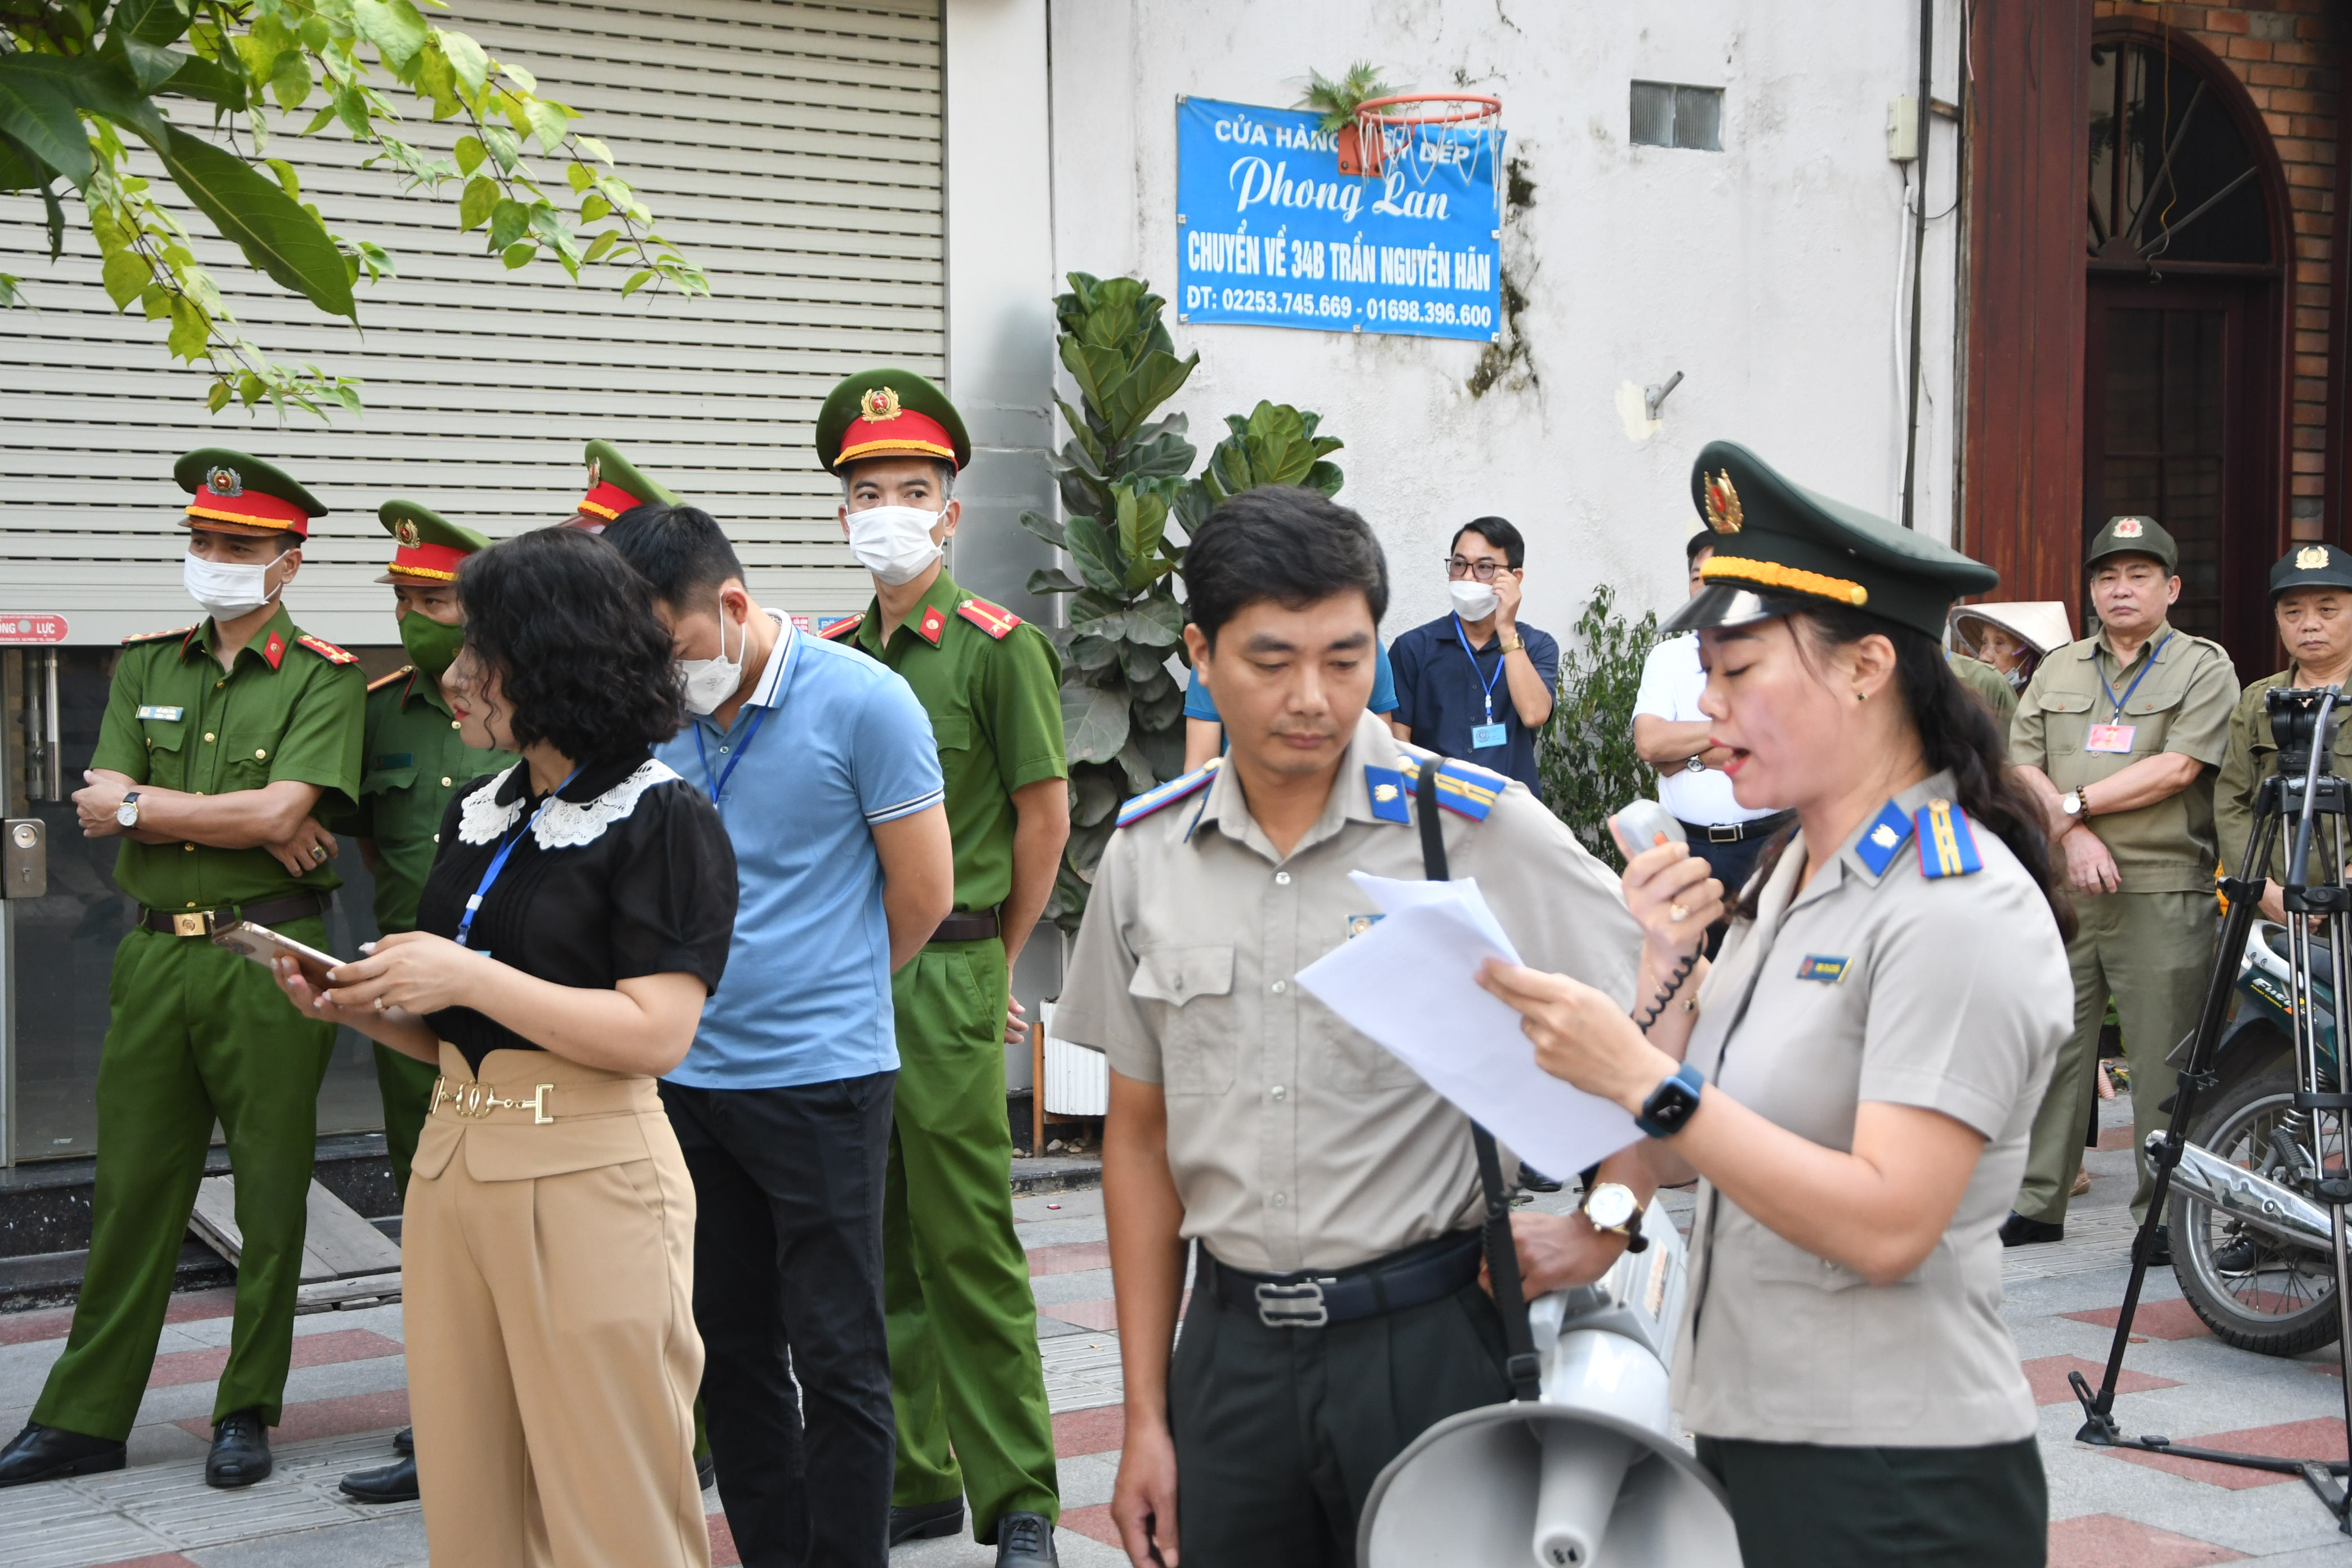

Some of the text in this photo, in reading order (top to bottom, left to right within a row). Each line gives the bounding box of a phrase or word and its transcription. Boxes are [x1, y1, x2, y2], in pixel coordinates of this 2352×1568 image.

[1215, 113, 1268, 145] CỬA
[1230, 156, 1450, 222] Phong Lan
[1187, 219, 1490, 292] CHUYỂN VỀ 34B TRẦN NGUYÊN HÃN
[1187, 285, 1217, 309] ĐT:
[1222, 288, 1352, 319] 02253.745.669
[1366, 297, 1491, 328] 01698.396.600
[36, 621, 55, 637] LỰC
